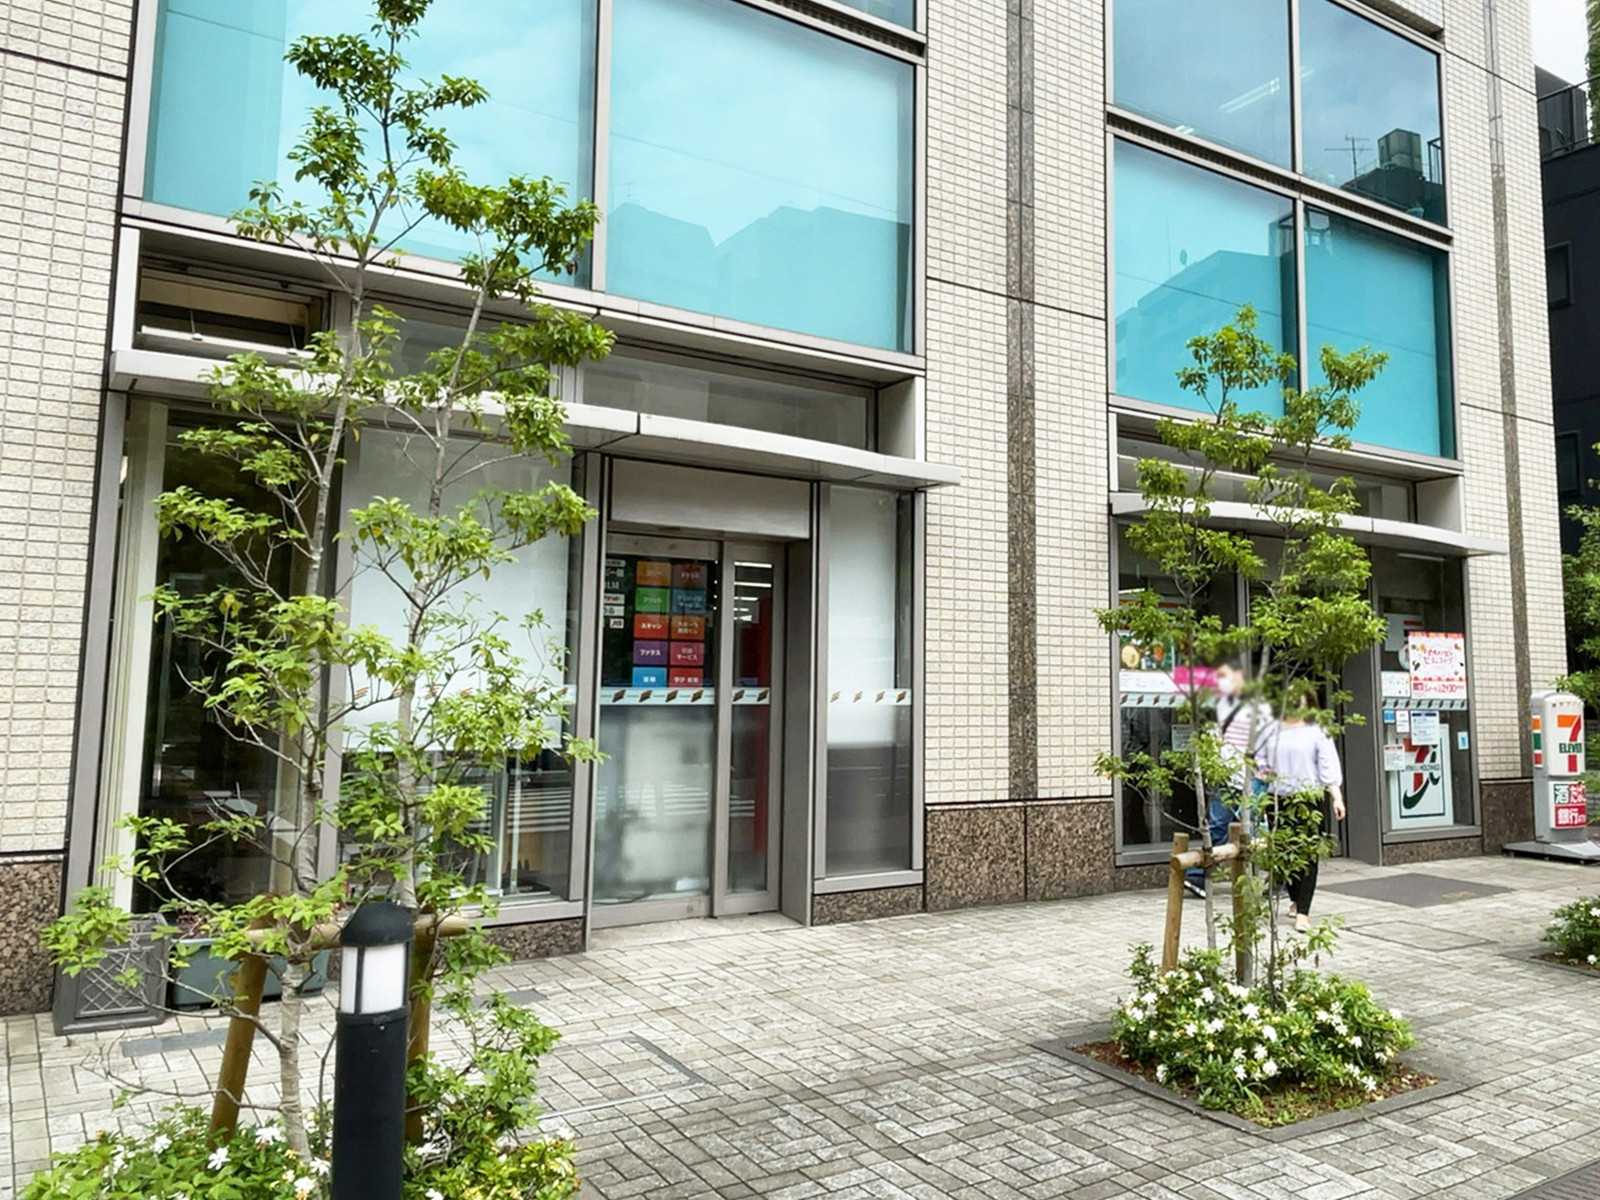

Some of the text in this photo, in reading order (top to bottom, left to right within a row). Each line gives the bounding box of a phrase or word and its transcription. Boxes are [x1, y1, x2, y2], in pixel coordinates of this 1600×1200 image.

[1557, 714, 1582, 772] 7
[1554, 784, 1569, 804] 酒
[1557, 808, 1579, 825] 銀行
